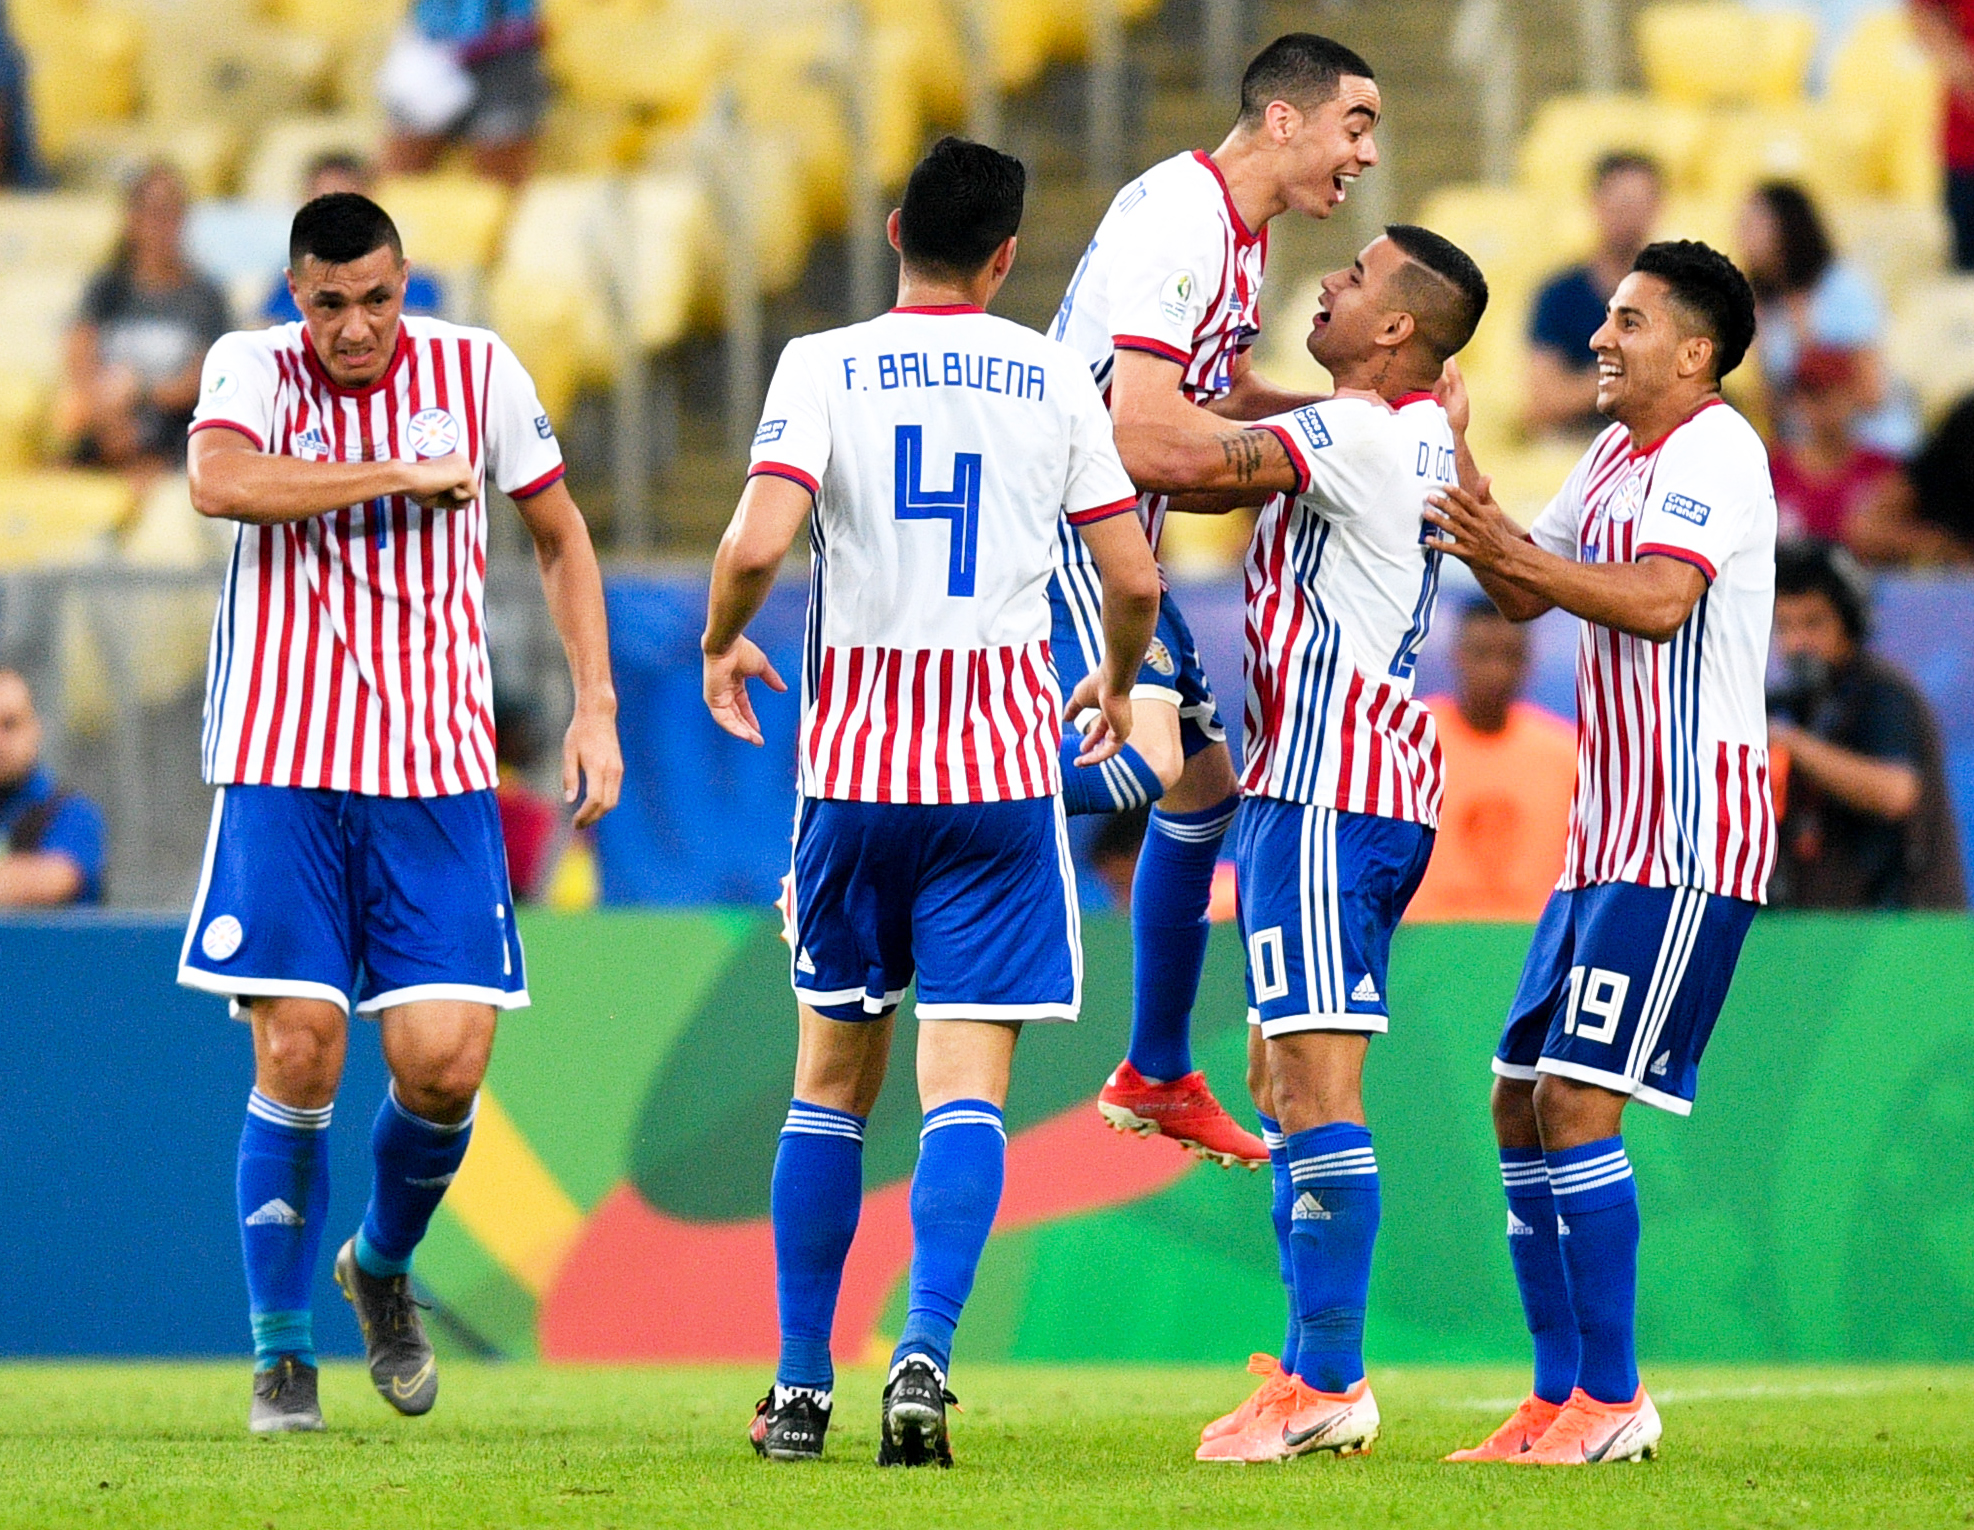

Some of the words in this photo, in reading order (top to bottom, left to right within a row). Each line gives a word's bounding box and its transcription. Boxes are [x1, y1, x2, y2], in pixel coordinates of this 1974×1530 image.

[843, 357, 868, 391] F.
[878, 352, 1045, 402] BALBUENA
[1294, 410, 1320, 446] grande
[1305, 407, 1322, 432] Cree
[1317, 431, 1330, 446] en
[1416, 440, 1431, 479] D.
[894, 424, 982, 598] 4
[1663, 501, 1703, 523] grande
[1667, 493, 1693, 510] Cree
[1693, 503, 1708, 516] en
[1564, 965, 1631, 1045] 19
[899, 1387, 931, 1399] COPA
[783, 1430, 815, 1442] COPA
